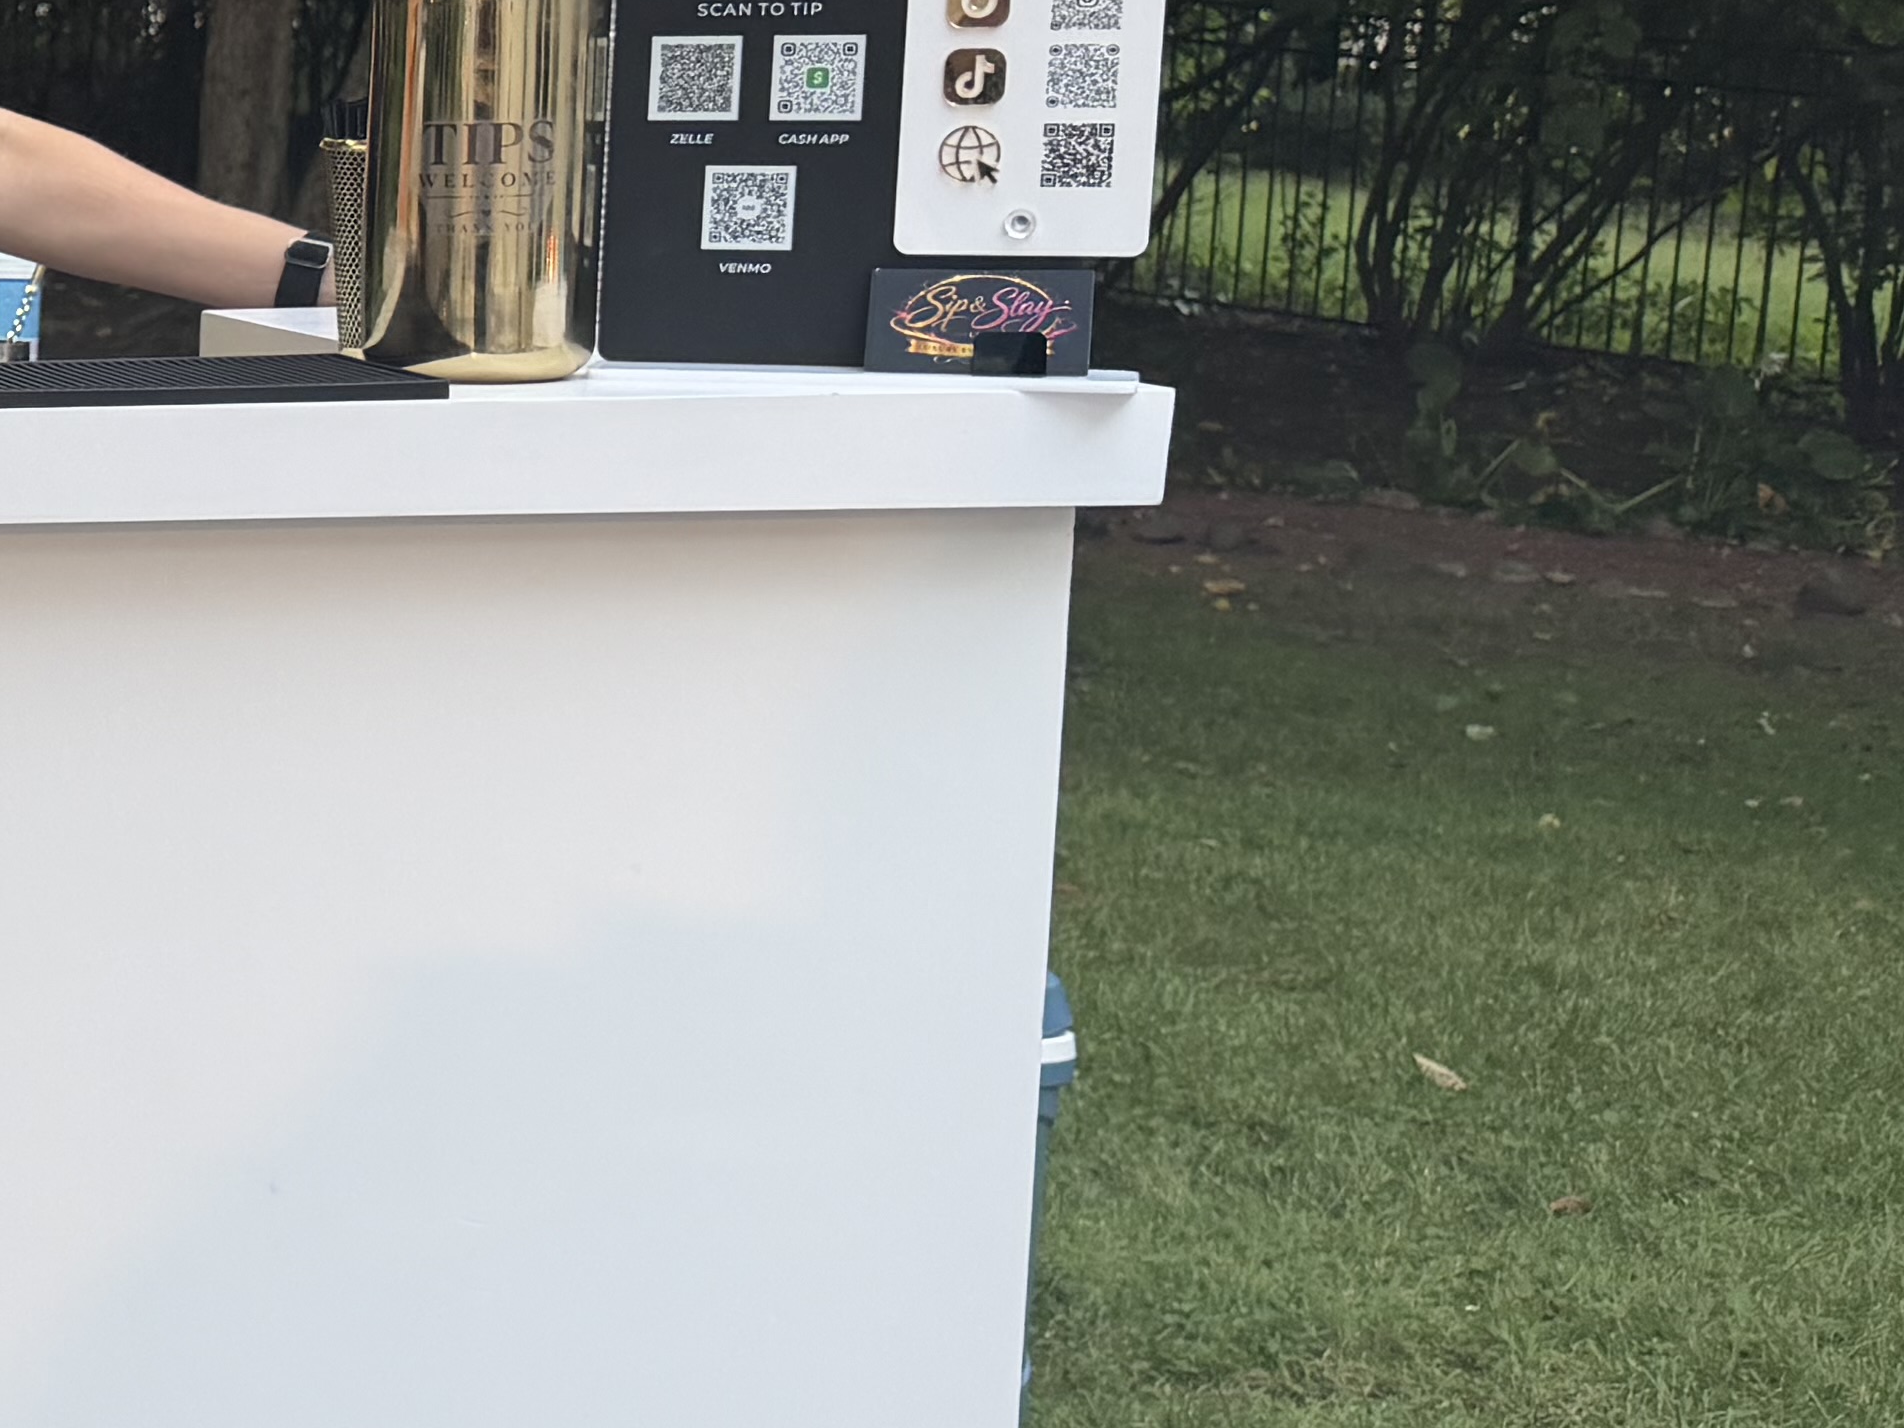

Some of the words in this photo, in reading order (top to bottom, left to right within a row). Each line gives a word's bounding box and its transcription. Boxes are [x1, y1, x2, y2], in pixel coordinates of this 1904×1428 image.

[697, 2, 752, 17] SCAN
[758, 2, 785, 16] TO
[791, 2, 823, 16] TIP
[423, 120, 554, 166] TIPS
[670, 133, 714, 145] ZELLE
[778, 134, 818, 145] CASH
[819, 134, 850, 145] APP
[419, 171, 555, 189] WELCOME
[719, 262, 772, 274] VENMO
[905, 285, 969, 332] Sip
[969, 295, 986, 313] &
[971, 287, 1059, 332] Slay
